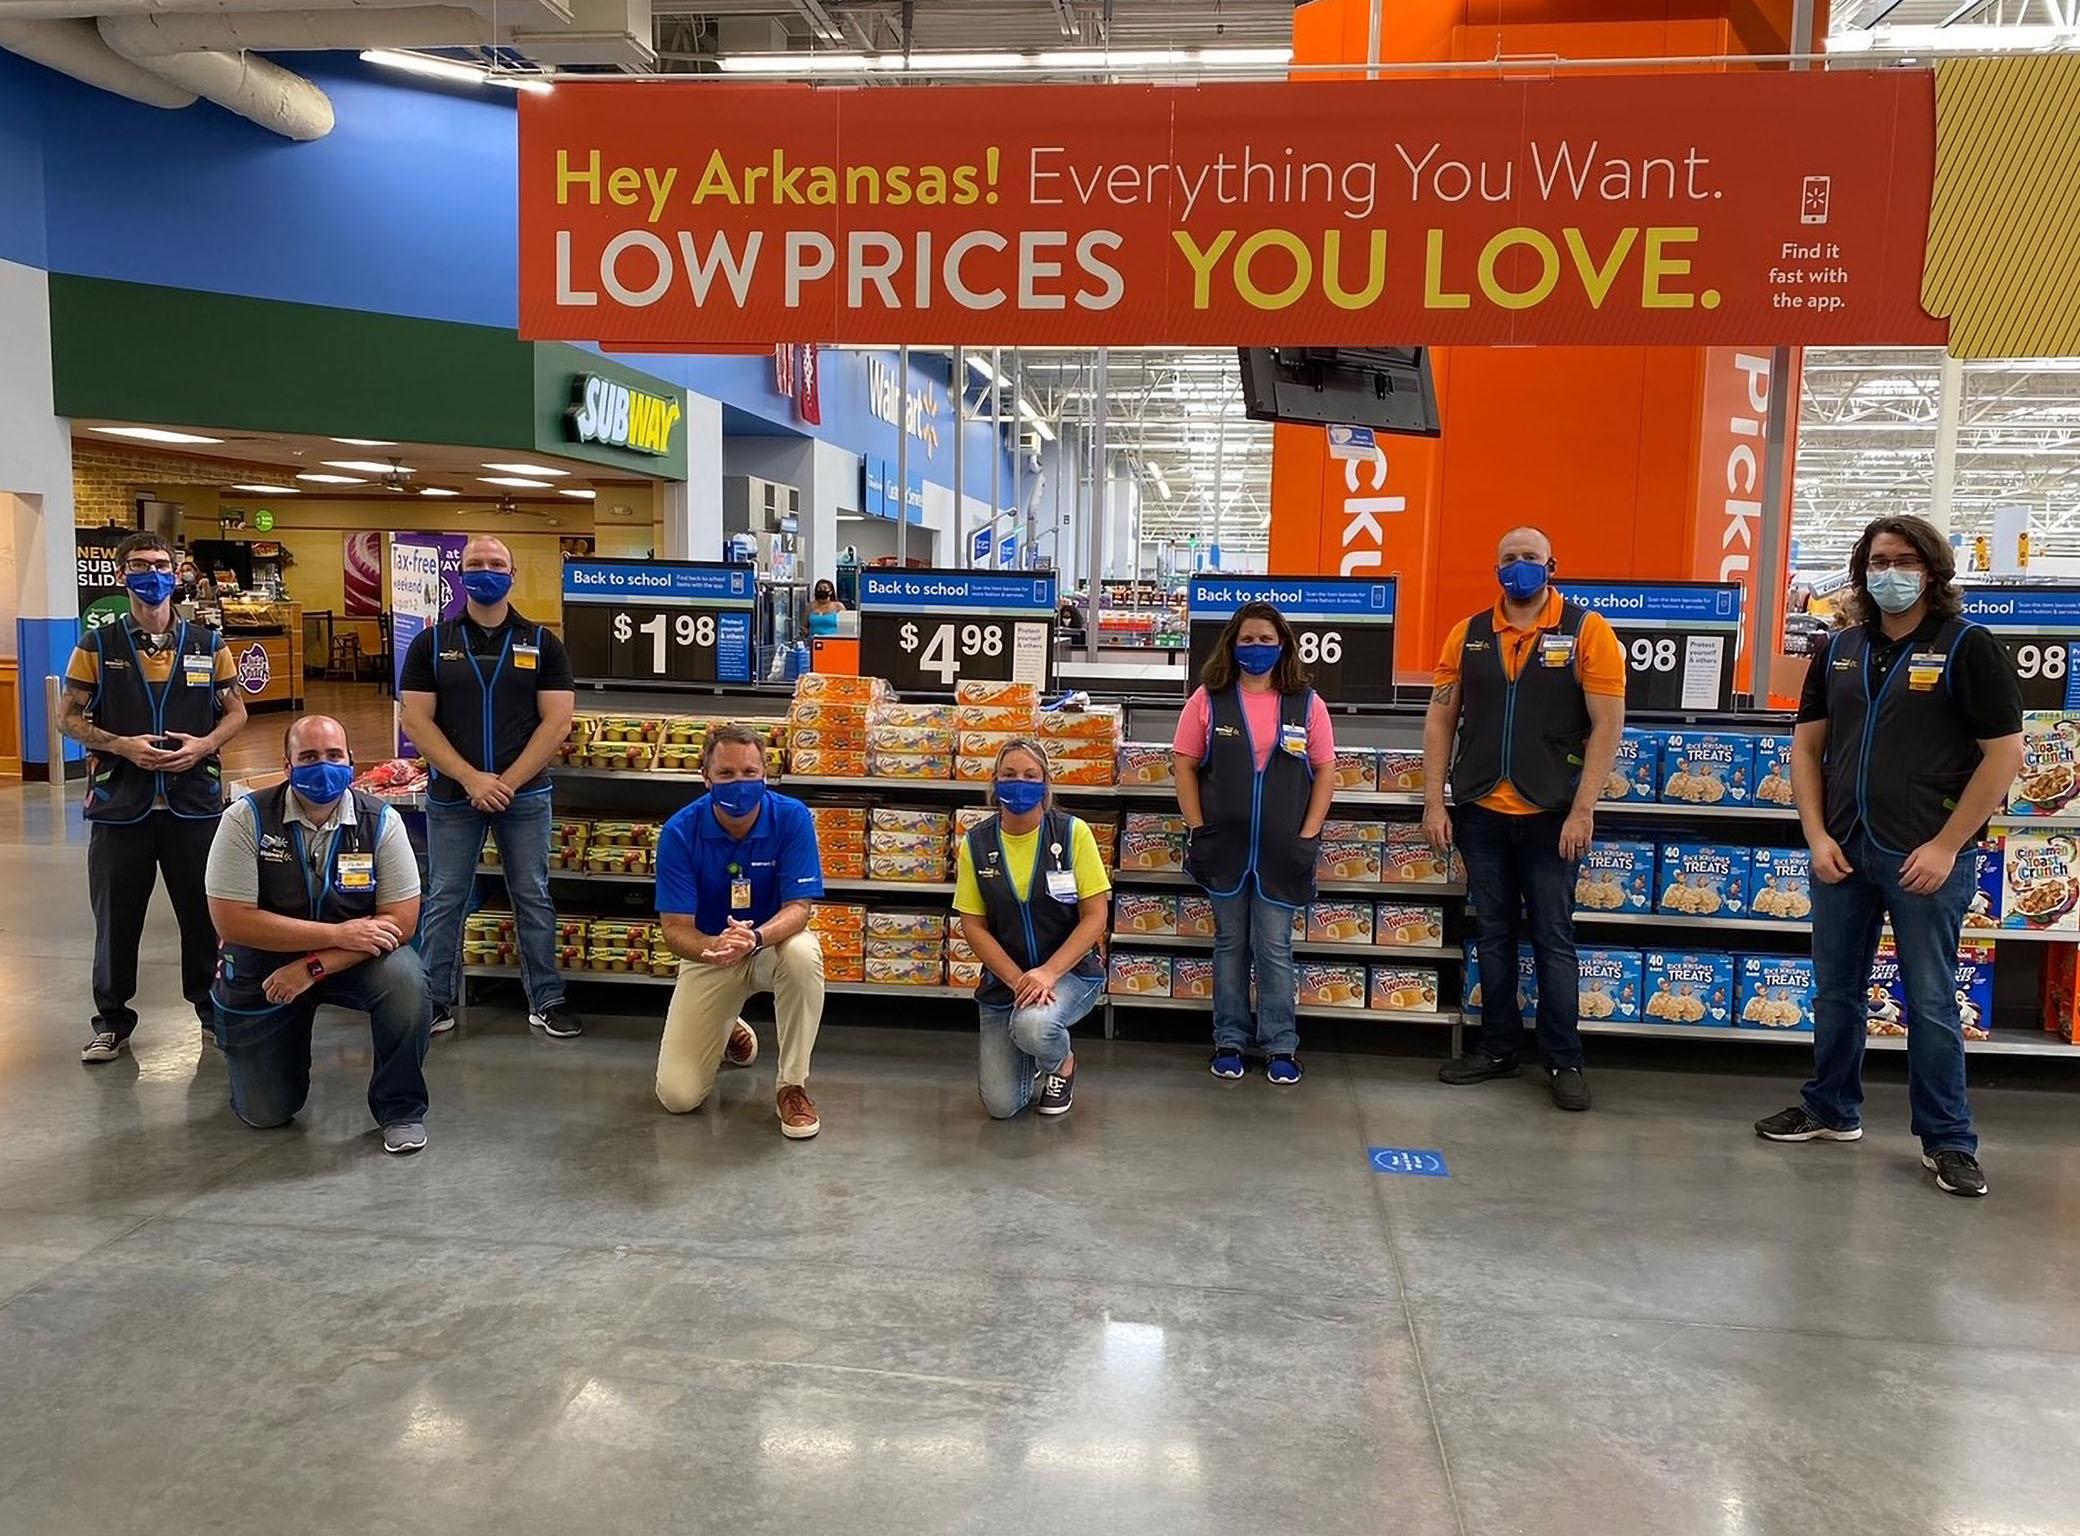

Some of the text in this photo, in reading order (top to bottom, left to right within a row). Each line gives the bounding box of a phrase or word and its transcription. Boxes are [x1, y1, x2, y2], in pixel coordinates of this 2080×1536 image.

[556, 140, 1723, 222] Hey Arkansas! Everything You Want.
[1782, 243, 1840, 259] Find it
[556, 225, 1721, 310] LOW PRICES YOU LOVE.
[1769, 267, 1848, 283] fast with
[1773, 292, 1845, 312] the app.
[577, 376, 681, 453] SUBWAY
[77, 546, 117, 559] NEW
[446, 549, 461, 559] at
[77, 560, 117, 573] SUB
[78, 574, 125, 587] SLID
[574, 571, 672, 587] Back to school
[868, 580, 901, 594] Back
[905, 582, 922, 595] to
[924, 582, 969, 596] school
[1197, 587, 1302, 603] Back to school
[1573, 594, 1589, 607] to
[1593, 594, 1643, 608] school
[1962, 599, 2014, 614] school
[1299, 631, 1343, 664] 86
[1668, 735, 1683, 747] 40
[1760, 737, 1775, 749] 40
[1615, 749, 1638, 759] ATS
[1687, 750, 1733, 763] TREATS
[2025, 748, 2074, 767] Crunch
[1665, 847, 1680, 858] 40
[1755, 851, 1770, 862] 40
[1589, 857, 1634, 870] TREATS
[1684, 862, 1729, 875] TREATS
[1775, 866, 1809, 877] TREA
[2019, 862, 2068, 881] Crunch
[1649, 955, 1664, 967] 40
[1745, 960, 1760, 971] 40
[1578, 966, 1622, 979] TREATS
[1668, 970, 1713, 983] TREATS
[1765, 975, 1810, 988] TREATS
